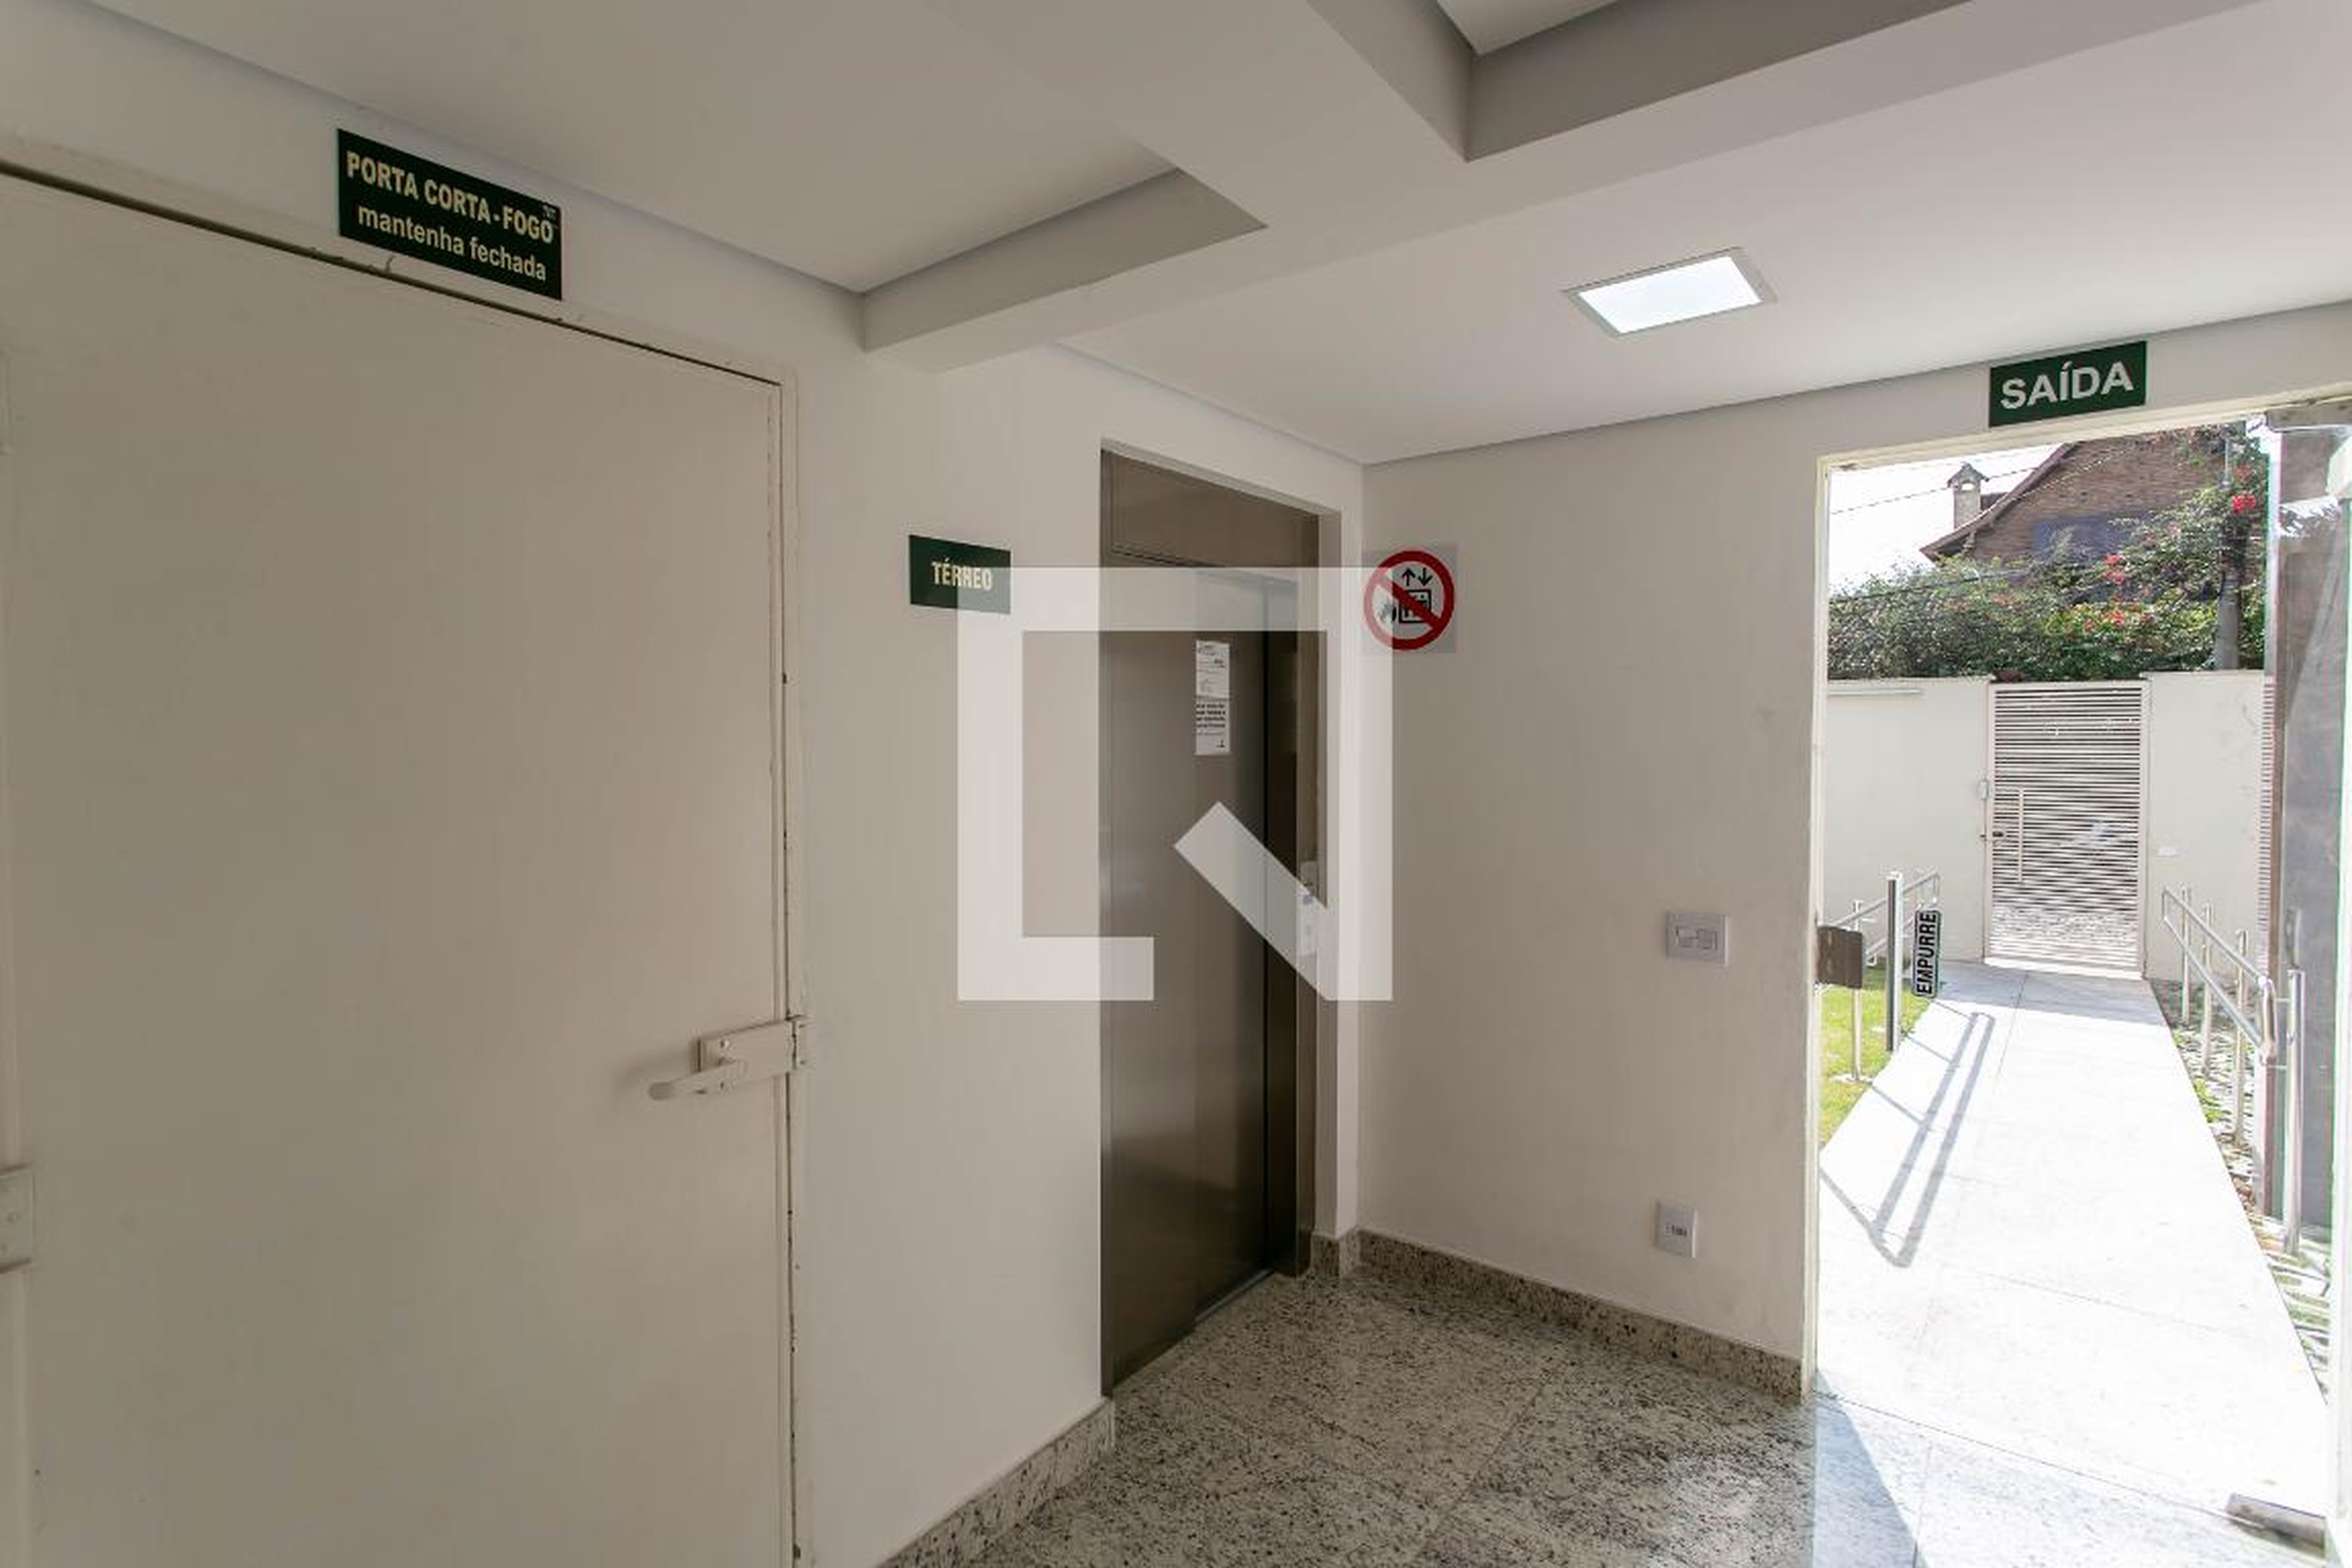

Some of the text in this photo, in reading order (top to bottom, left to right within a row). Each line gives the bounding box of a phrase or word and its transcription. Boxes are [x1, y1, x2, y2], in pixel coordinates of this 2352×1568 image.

[347, 151, 418, 200] PORTA
[358, 205, 546, 281] mantenha fechada
[2000, 361, 2134, 409] SAÍDA
[931, 557, 993, 591] TÉRREO
[1916, 912, 1936, 994] EMPURRE
